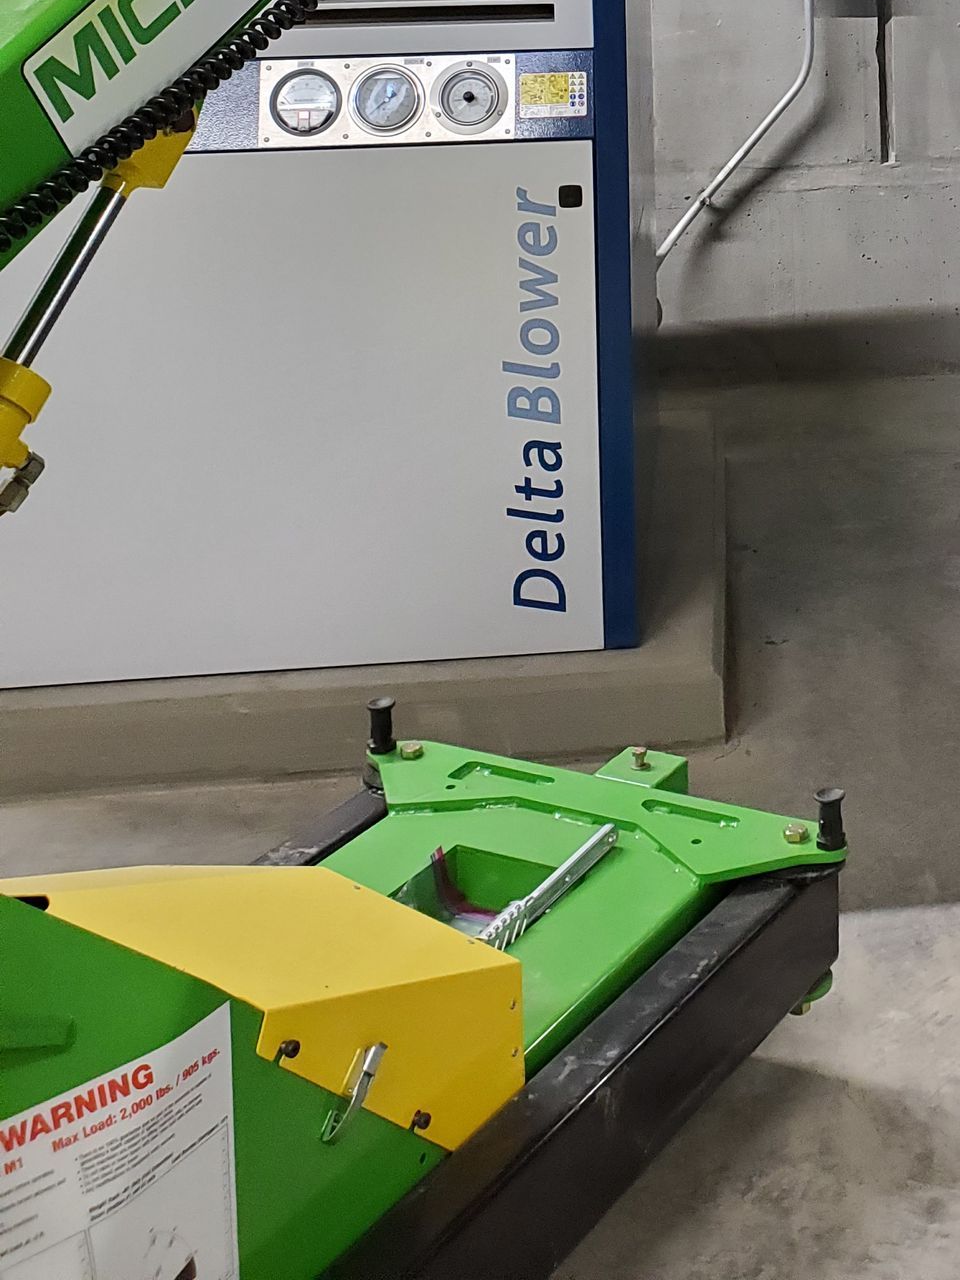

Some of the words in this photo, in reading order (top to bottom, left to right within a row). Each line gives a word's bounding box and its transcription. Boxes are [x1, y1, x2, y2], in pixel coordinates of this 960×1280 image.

[0, 1063, 154, 1152] WARNING
[52, 1134, 79, 1153] Max
[83, 1114, 118, 1139] Load:
[119, 1094, 153, 1121] 2,000
[155, 1082, 174, 1101] lbs.
[181, 1060, 200, 1081] 905
[201, 1048, 221, 1066] kgs.
